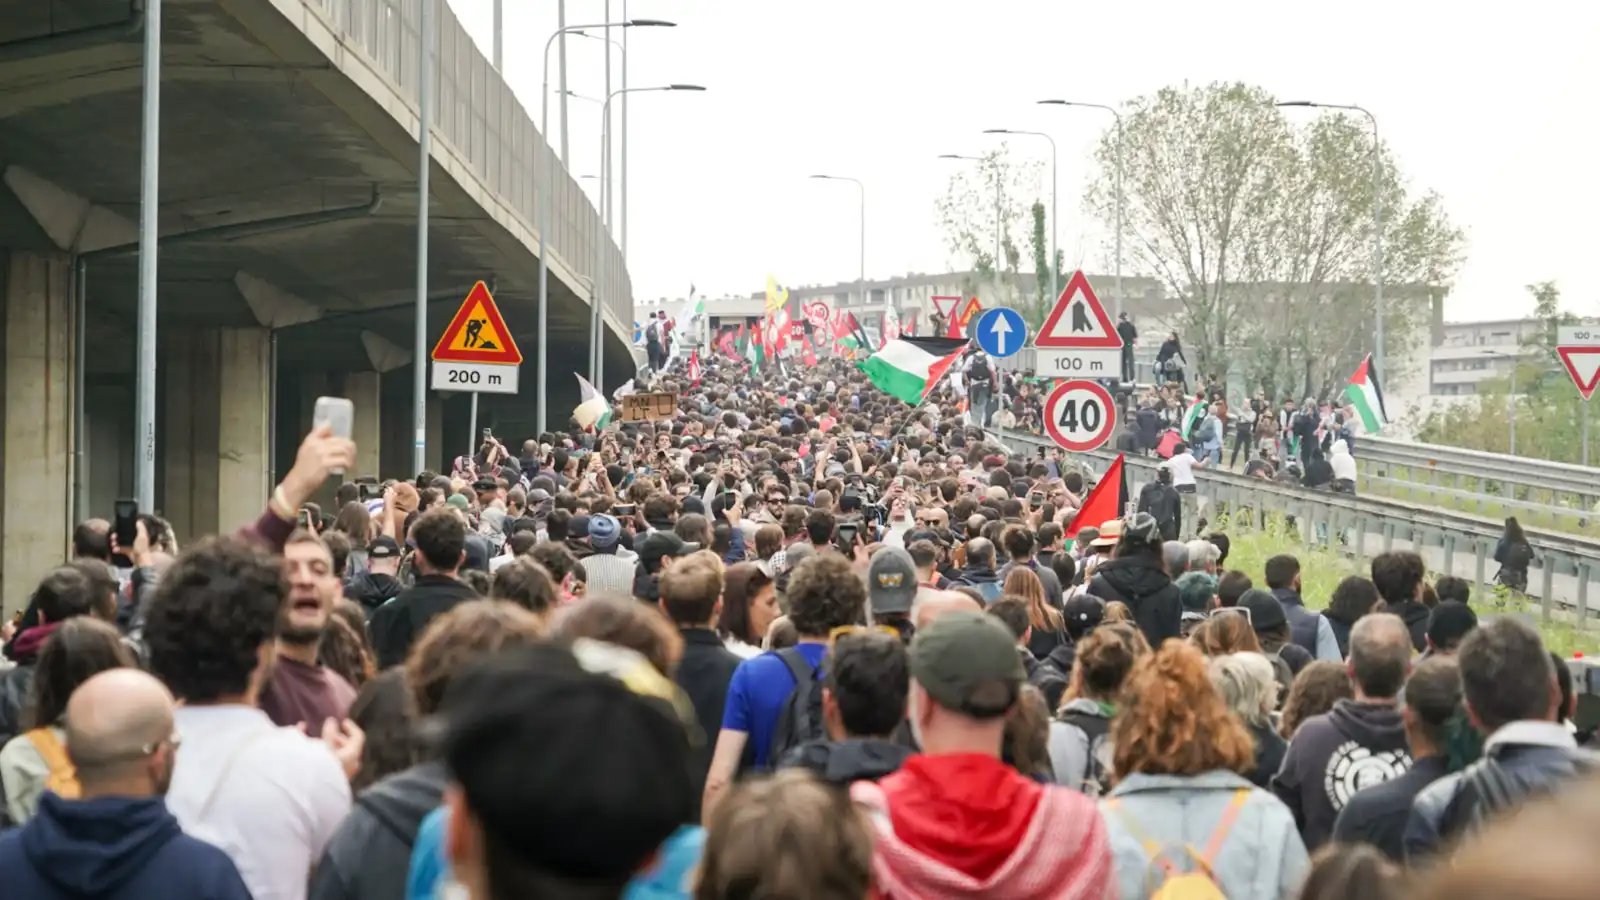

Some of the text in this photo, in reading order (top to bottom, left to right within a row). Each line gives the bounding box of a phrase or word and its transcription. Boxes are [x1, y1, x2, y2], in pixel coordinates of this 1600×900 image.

[1574, 331, 1590, 340] 100
[1054, 357, 1103, 370] 100 m
[448, 369, 502, 385] 200 m
[1058, 399, 1101, 433] 40
